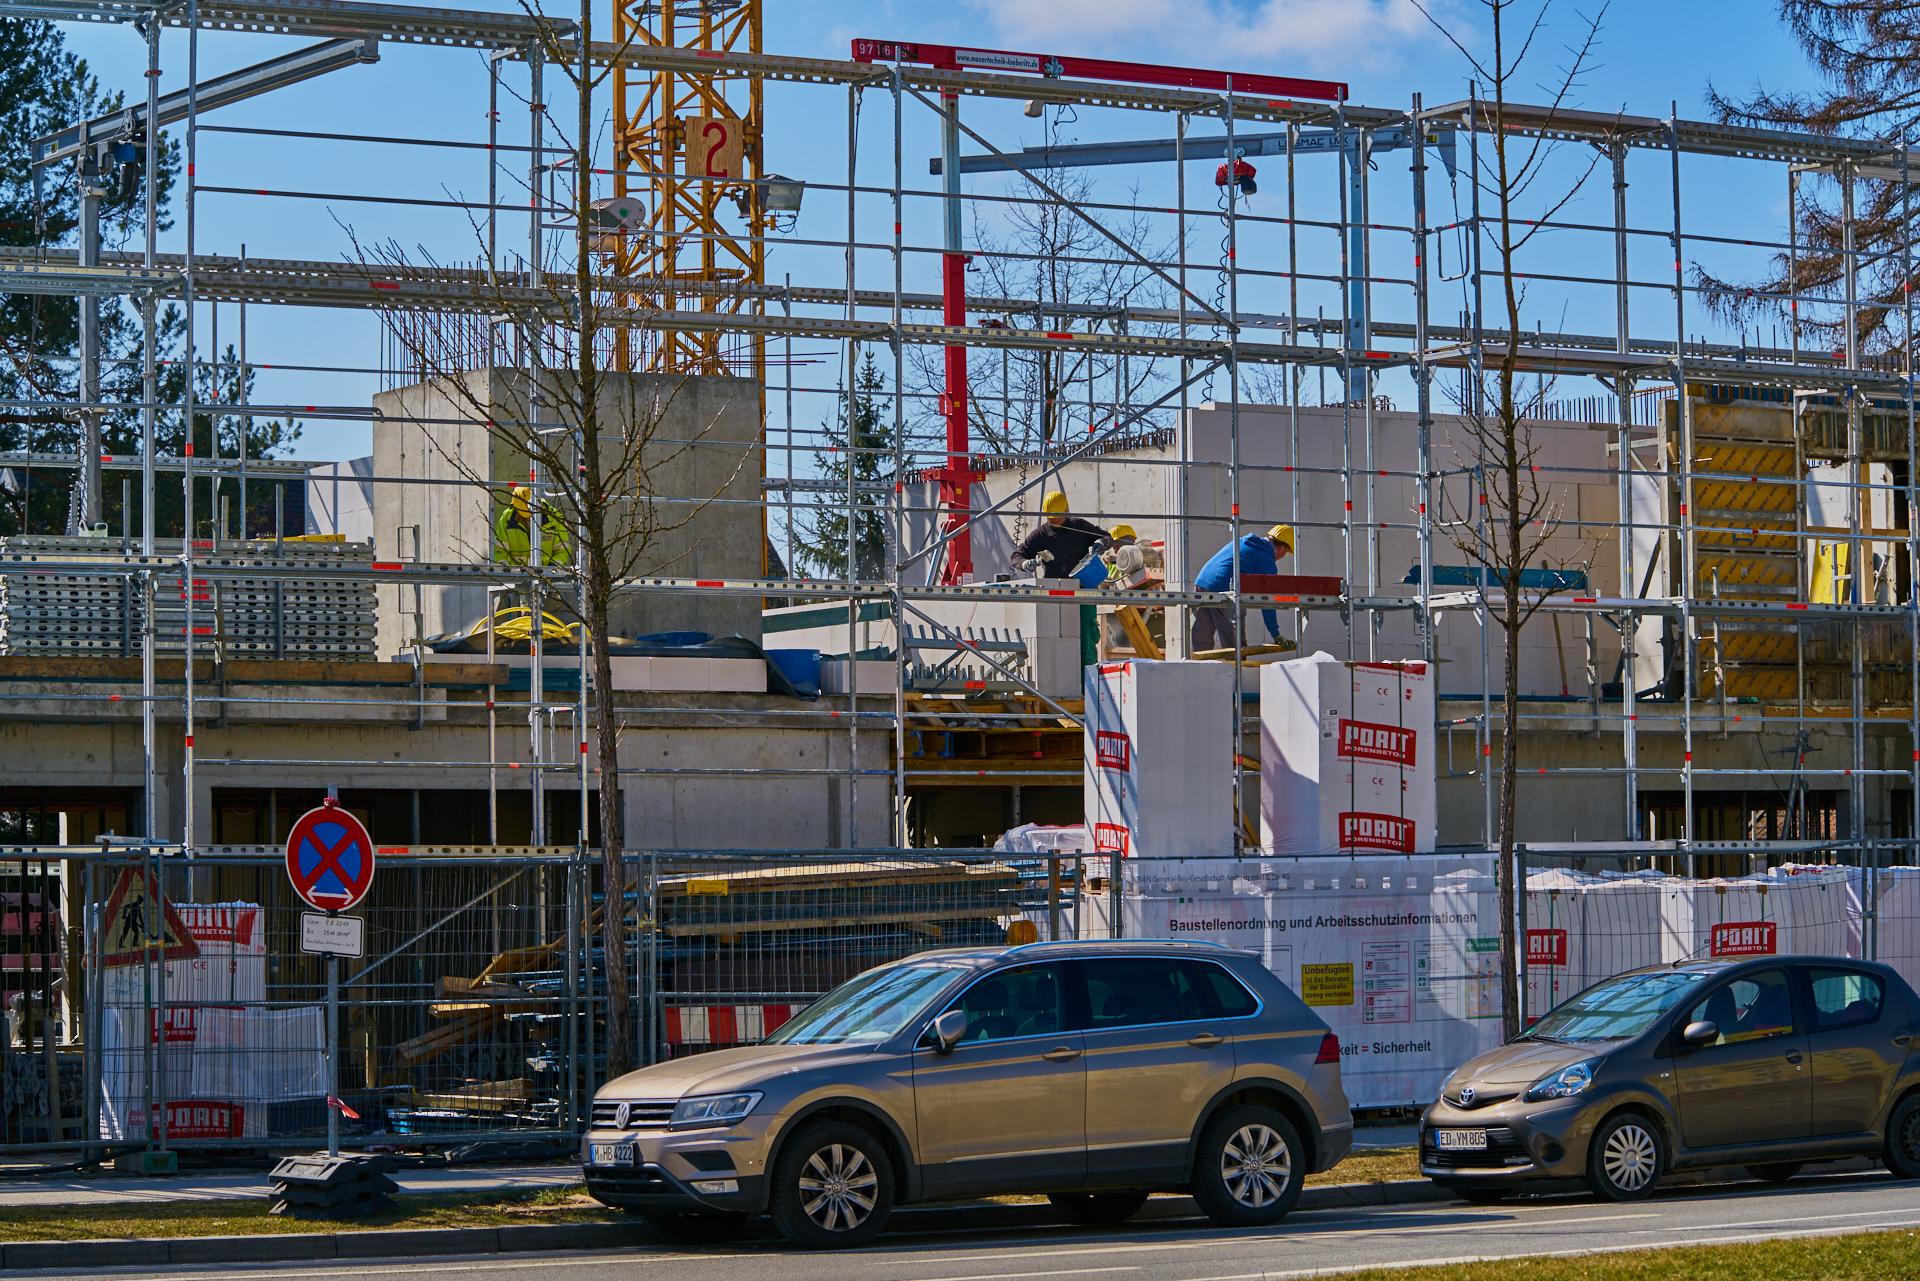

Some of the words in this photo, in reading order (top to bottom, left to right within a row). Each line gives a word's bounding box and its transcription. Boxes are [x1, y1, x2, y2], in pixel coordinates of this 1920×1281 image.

[702, 121, 728, 177] 2
[1278, 138, 1324, 147] LISMAC
[1344, 725, 1409, 753] PORIT
[1099, 736, 1126, 759] PORIT
[1344, 745, 1406, 759] PORENBETON
[1344, 818, 1408, 841] PORIT
[1344, 836, 1406, 847] PORENBETON
[1169, 916, 1287, 931] Baustellenordnung
[1290, 915, 1312, 929] und
[1315, 912, 1477, 928] Arbeitsschutzinformationen
[1715, 927, 1770, 948] PORIT
[1715, 945, 1768, 954] PORENBETON
[1304, 965, 1350, 976] Unbefugten
[1325, 975, 1350, 983] Betreten
[1305, 991, 1323, 999] streng
[1324, 990, 1350, 998] verboten
[1372, 1040, 1431, 1054] Sicherheit
[1440, 1131, 1452, 1145] ED
[1456, 1131, 1468, 1145] YM
[1469, 1131, 1486, 1145] 805
[594, 1144, 600, 1162] M
[602, 1144, 613, 1161] HB
[614, 1144, 633, 1161] 4222
